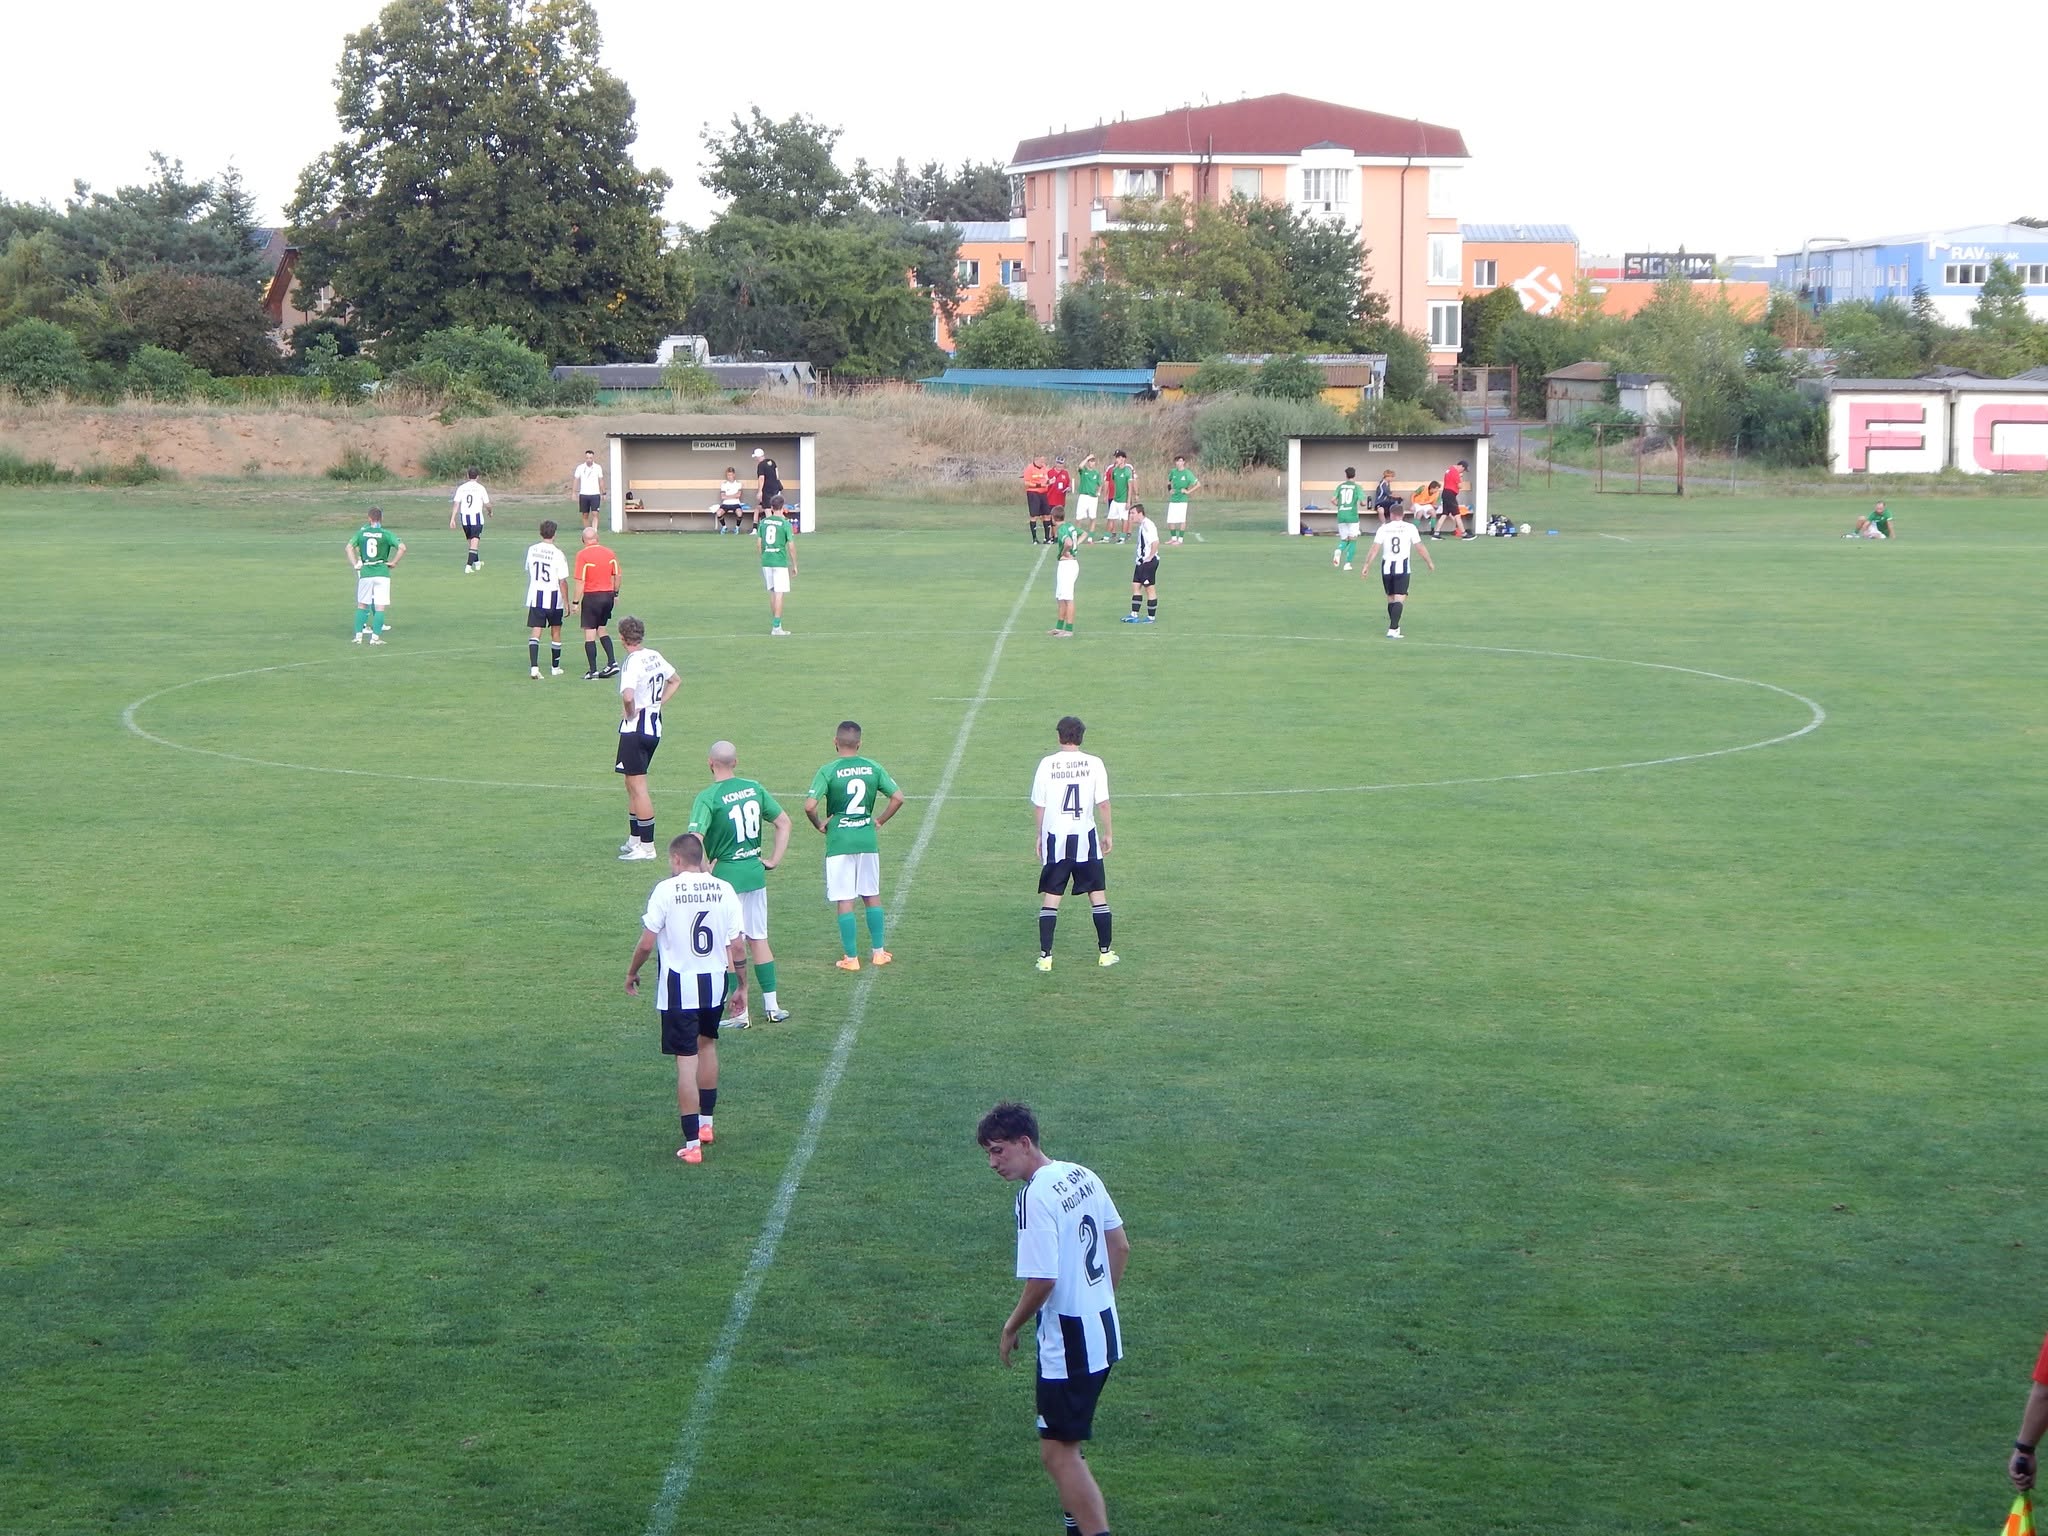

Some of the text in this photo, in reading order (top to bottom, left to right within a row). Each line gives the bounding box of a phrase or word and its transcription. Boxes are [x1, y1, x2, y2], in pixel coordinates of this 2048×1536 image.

[1951, 246, 1985, 260] RAV
[466, 494, 473, 508] 9
[1391, 536, 1400, 554] 8
[532, 561, 551, 583] 15
[648, 672, 664, 704] 12
[836, 766, 873, 779] KONICE
[1066, 760, 1088, 769] SIGMA
[1051, 770, 1090, 779] HODOLANY
[722, 788, 757, 804] KONICE
[846, 778, 867, 815] 2
[1061, 784, 1083, 820] 4
[728, 800, 760, 843] 18
[675, 882, 721, 893] FC SIGMA
[675, 893, 723, 905] HODOLANY
[690, 911, 714, 958] 6
[1052, 1181, 1068, 1196] FC
[1079, 1214, 1105, 1287] 2
